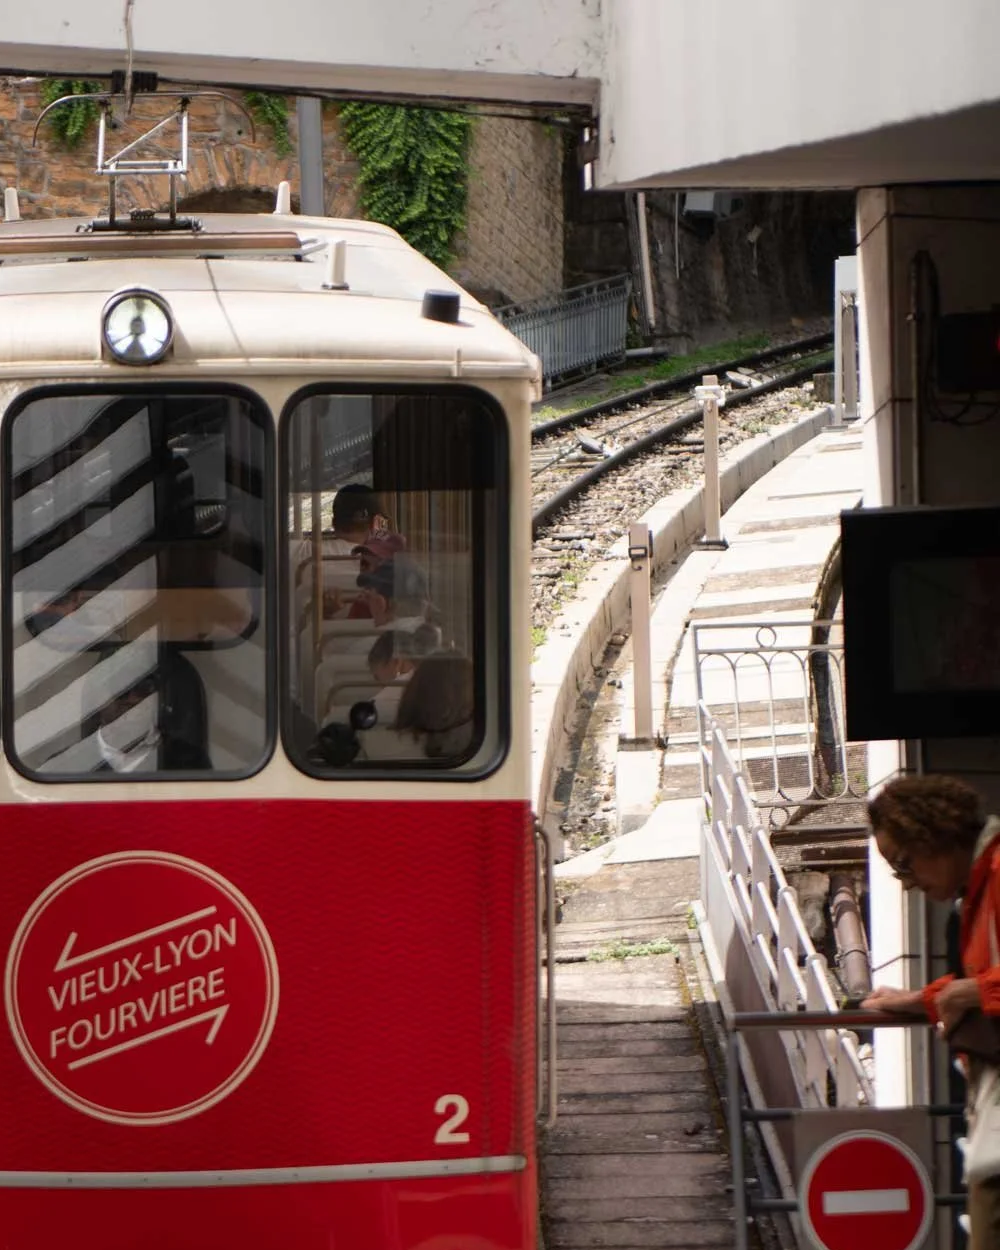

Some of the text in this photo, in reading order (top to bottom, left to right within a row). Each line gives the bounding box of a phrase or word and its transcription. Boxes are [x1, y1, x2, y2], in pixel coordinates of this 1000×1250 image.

[48, 917, 237, 1011] VIEUX-LYON
[50, 967, 225, 1058] FOURVIERE
[434, 1094, 470, 1144] 2
